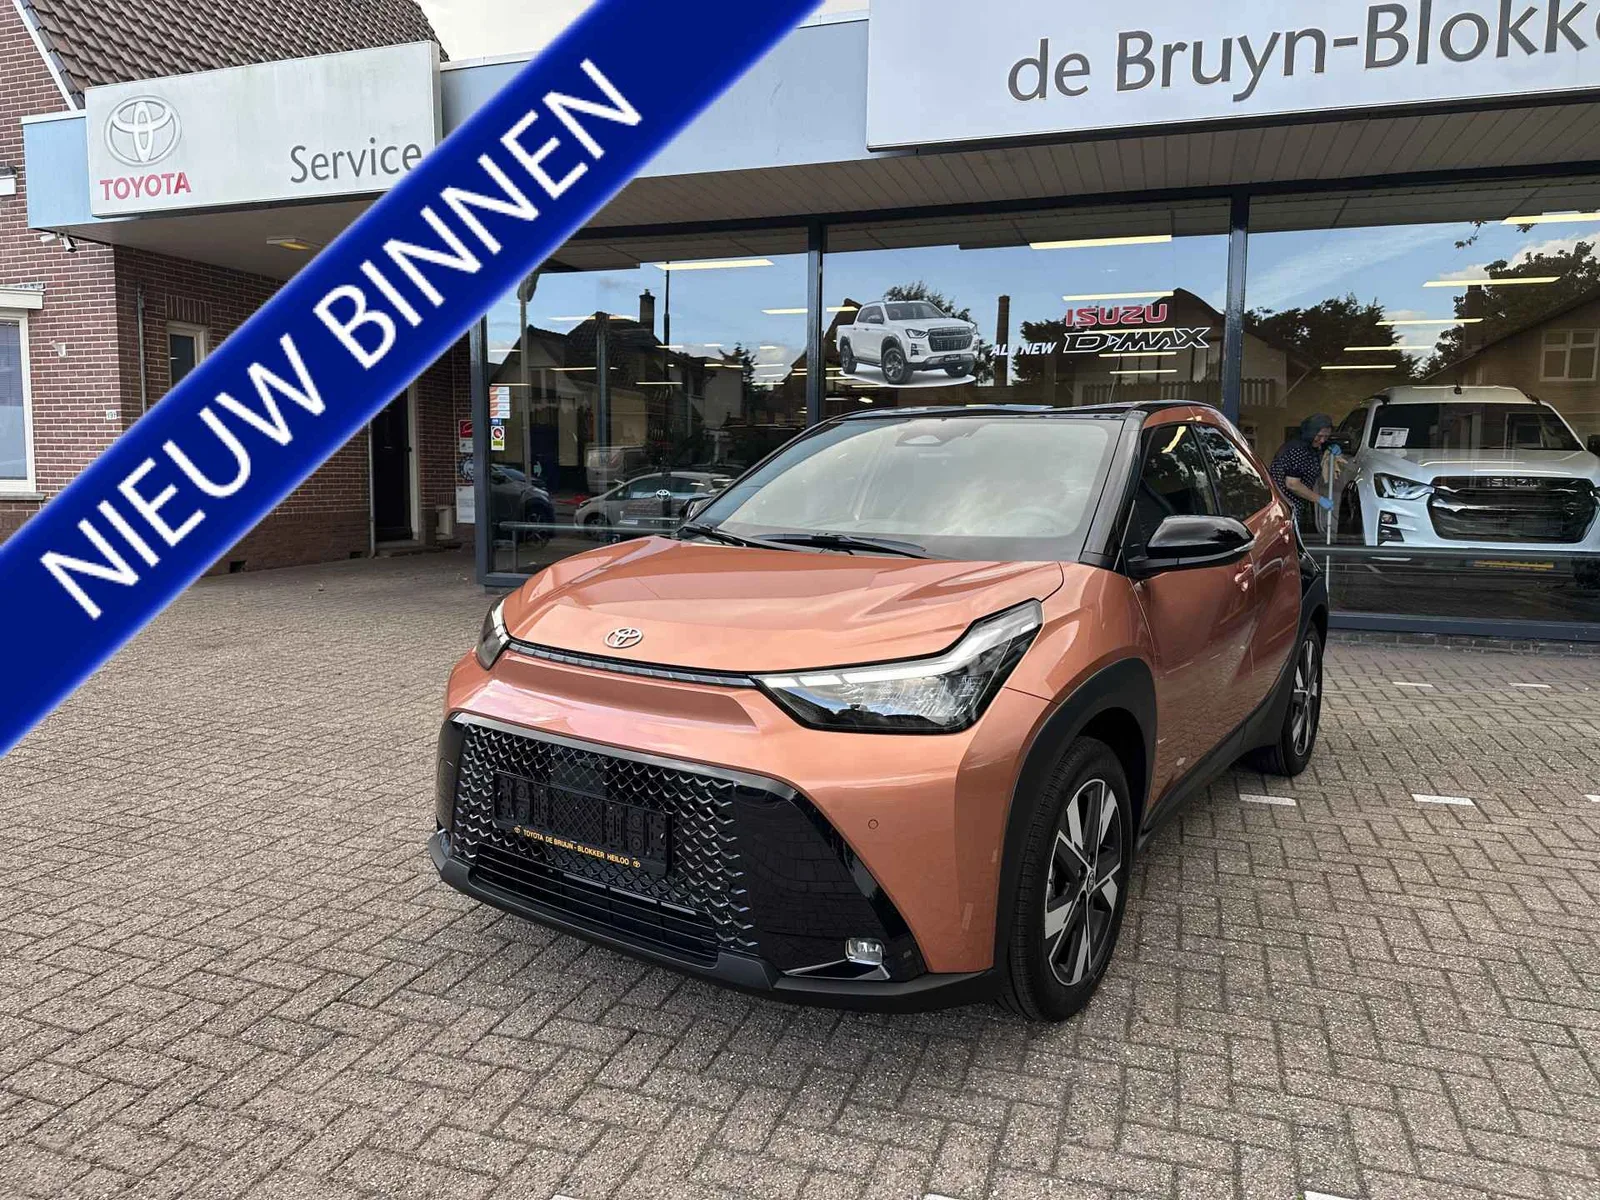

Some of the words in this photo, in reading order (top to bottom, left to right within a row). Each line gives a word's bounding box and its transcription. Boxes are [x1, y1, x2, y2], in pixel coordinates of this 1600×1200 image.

[1007, 38, 1091, 102] de
[1115, 0, 1600, 103] Bruyn-Blokk
[290, 137, 422, 184] Service
[100, 172, 192, 200] TOYOTA
[1065, 303, 1168, 327] ISUZU
[1019, 341, 1058, 355] NEW
[1486, 477, 1542, 488] ISUZU
[523, 829, 544, 841] TOYOTA
[545, 836, 553, 844] DE
[577, 845, 605, 859] BLOKKER
[607, 853, 630, 866] HEILOO
